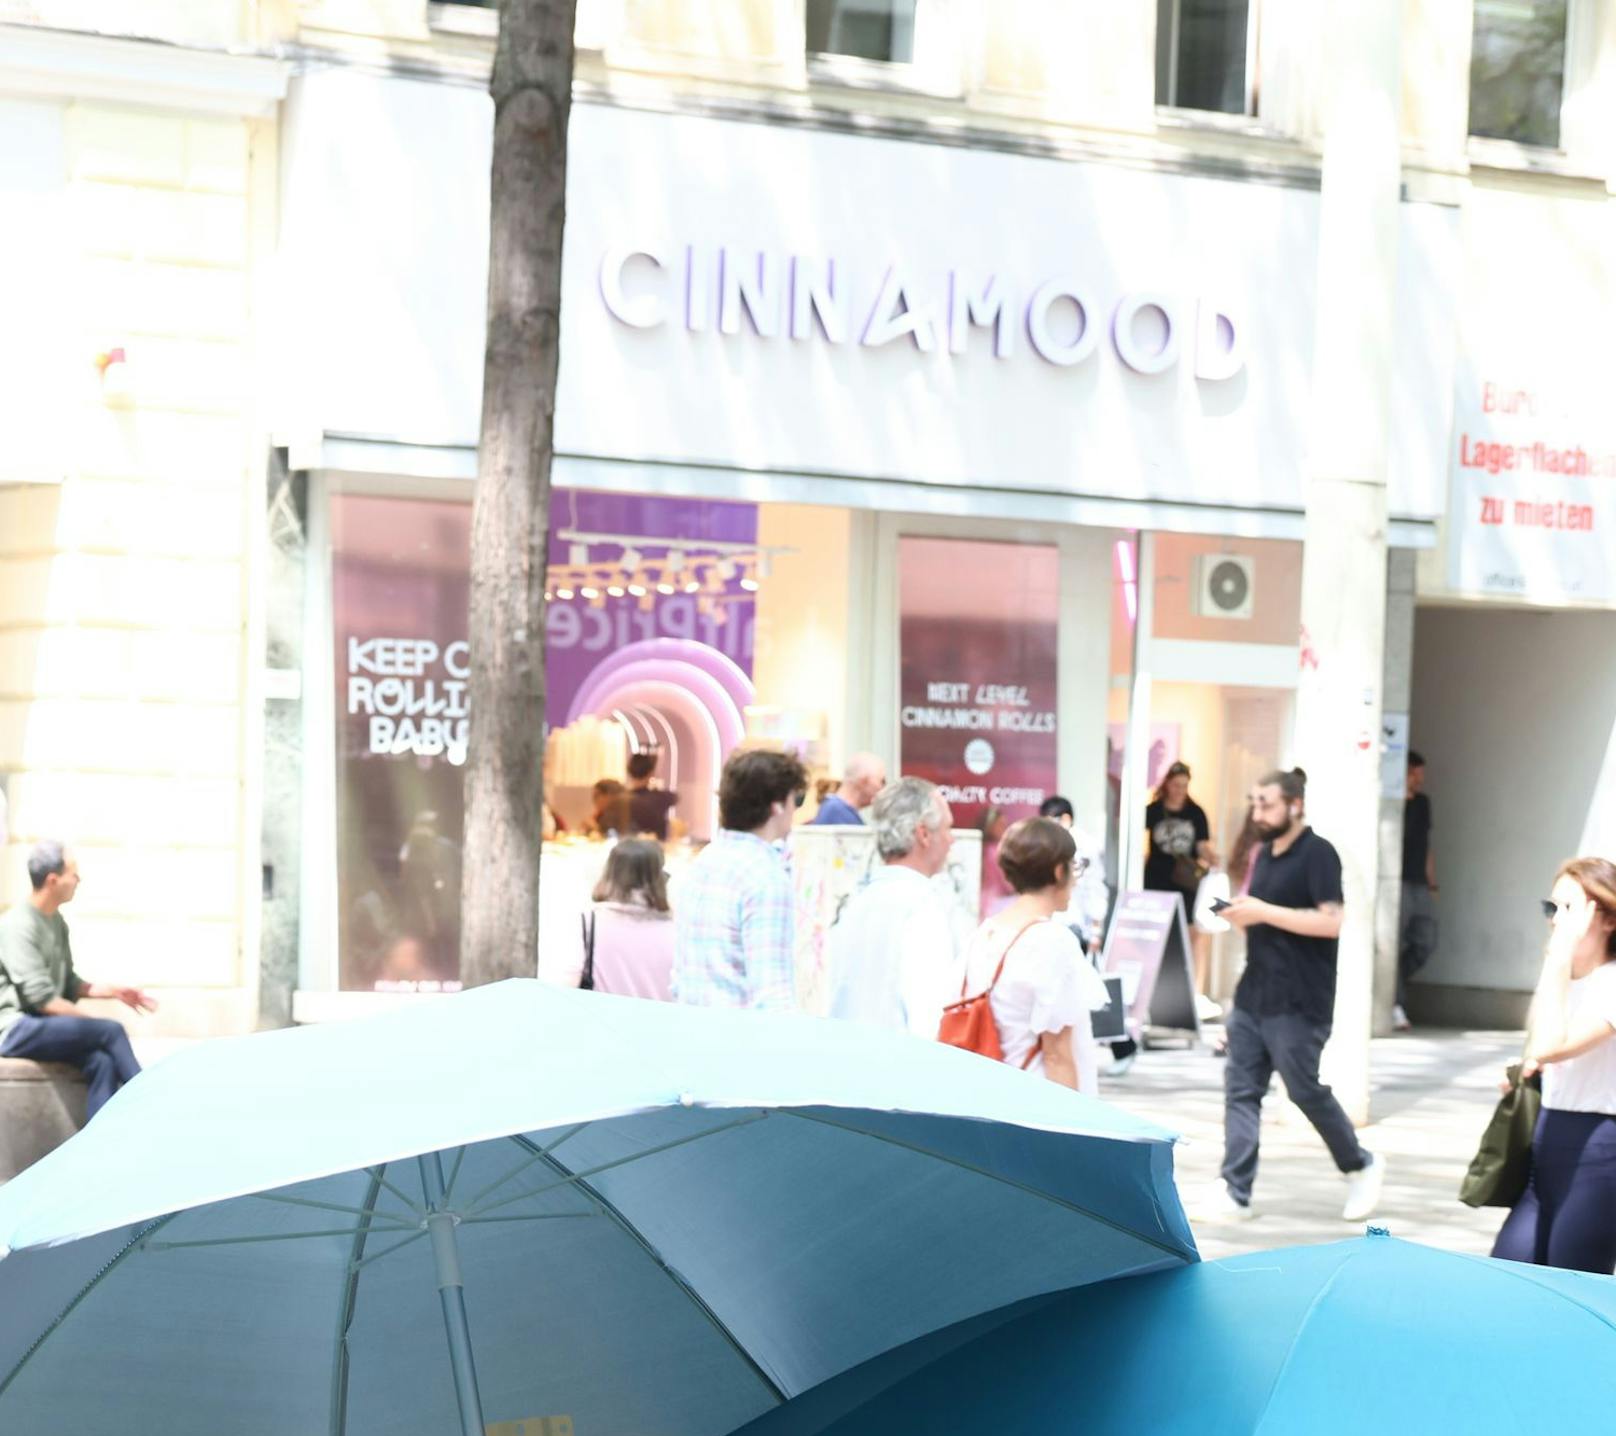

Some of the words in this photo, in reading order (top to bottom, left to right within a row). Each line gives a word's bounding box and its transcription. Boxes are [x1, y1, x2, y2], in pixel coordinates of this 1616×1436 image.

[600, 244, 1247, 381] CINNAMOOD
[1514, 496, 1595, 532] mieten
[348, 637, 439, 676] KEEP
[348, 677, 470, 717] ROLLI
[369, 716, 469, 766] BABY
